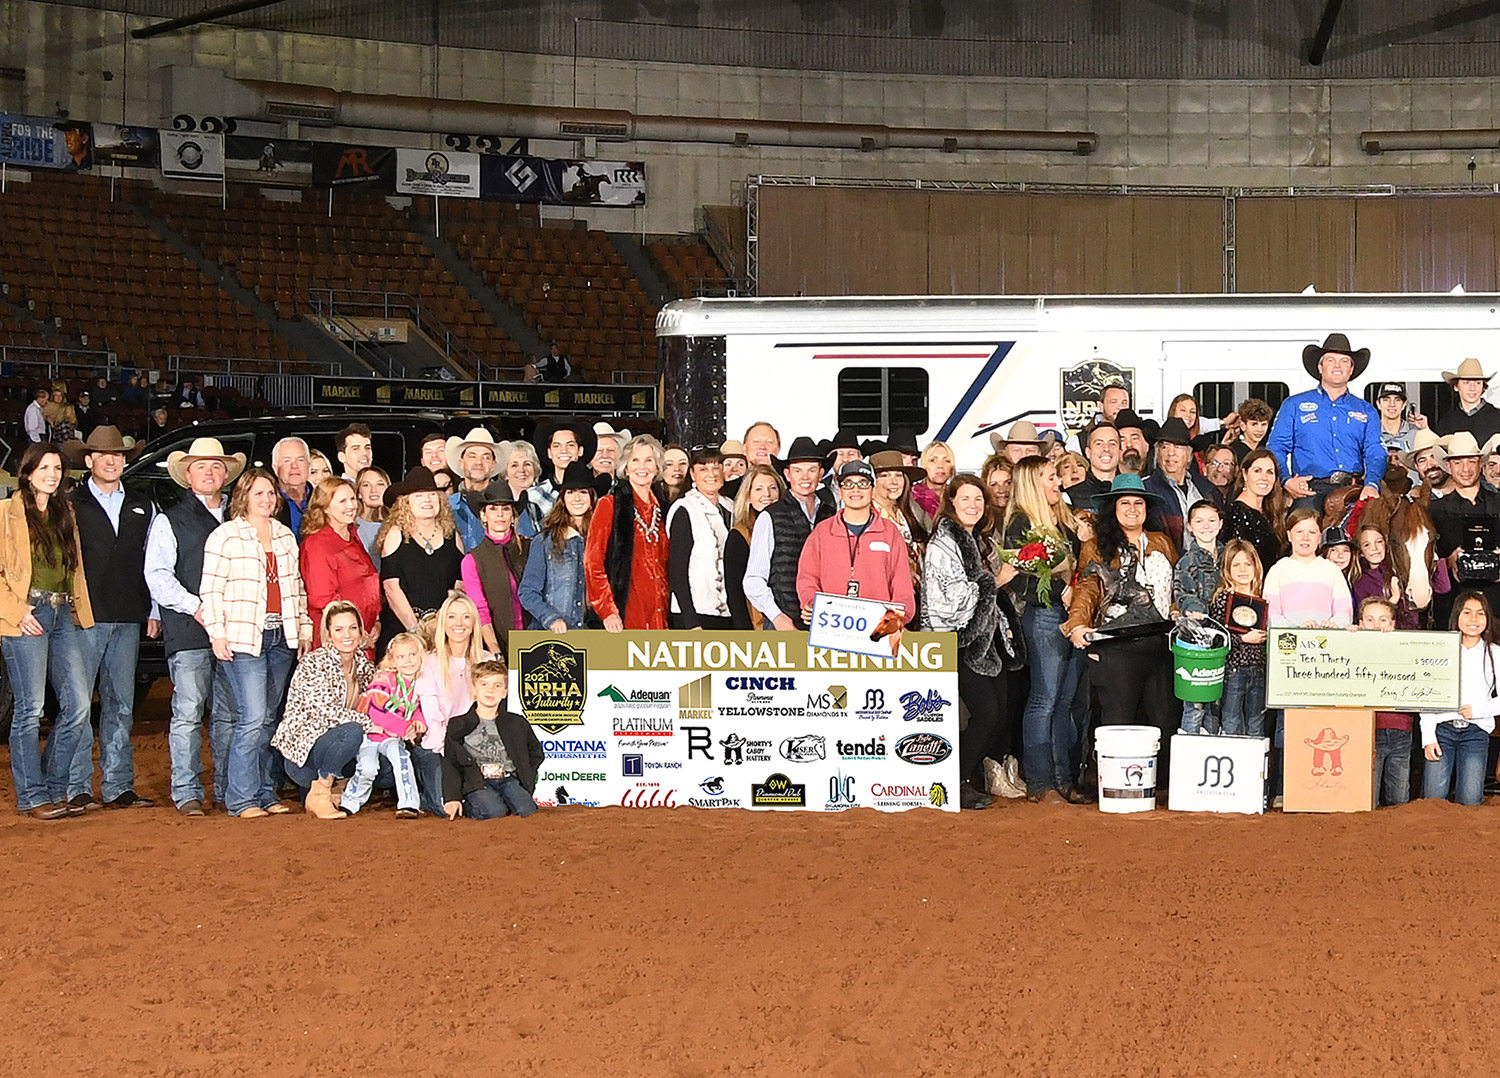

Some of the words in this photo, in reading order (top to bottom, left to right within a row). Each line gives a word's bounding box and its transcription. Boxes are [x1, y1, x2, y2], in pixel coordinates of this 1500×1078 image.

[11, 123, 31, 137] FOR
[35, 125, 55, 140] THE
[321, 384, 361, 399] MARKEL
[404, 387, 445, 401] MARKEL
[488, 390, 529, 404] MARKEL
[574, 392, 616, 406] MARKEL
[818, 611, 868, 632] $300
[627, 641, 796, 670] NATIONAL
[1320, 653, 1351, 666] Thirty
[524, 673, 549, 682] 2021
[1286, 666, 1313, 679] Three
[1314, 667, 1351, 679] hundred
[1355, 666, 1377, 683] fifty
[523, 682, 583, 697] NRHA
[725, 676, 795, 690] CINCH
[532, 694, 575, 710] Futurity
[630, 689, 670, 703] Adequan
[679, 709, 712, 719] MARKEL
[718, 707, 805, 716] YELLOWSTONE
[613, 717, 674, 731] PLATINUM
[836, 738, 886, 756] tenda
[644, 761, 663, 769] TOYON
[664, 761, 683, 769] RANCH
[541, 772, 570, 781] JOHN
[571, 772, 607, 781] DEERE
[871, 783, 928, 797] CARDINAL
[535, 797, 556, 808] lassic
